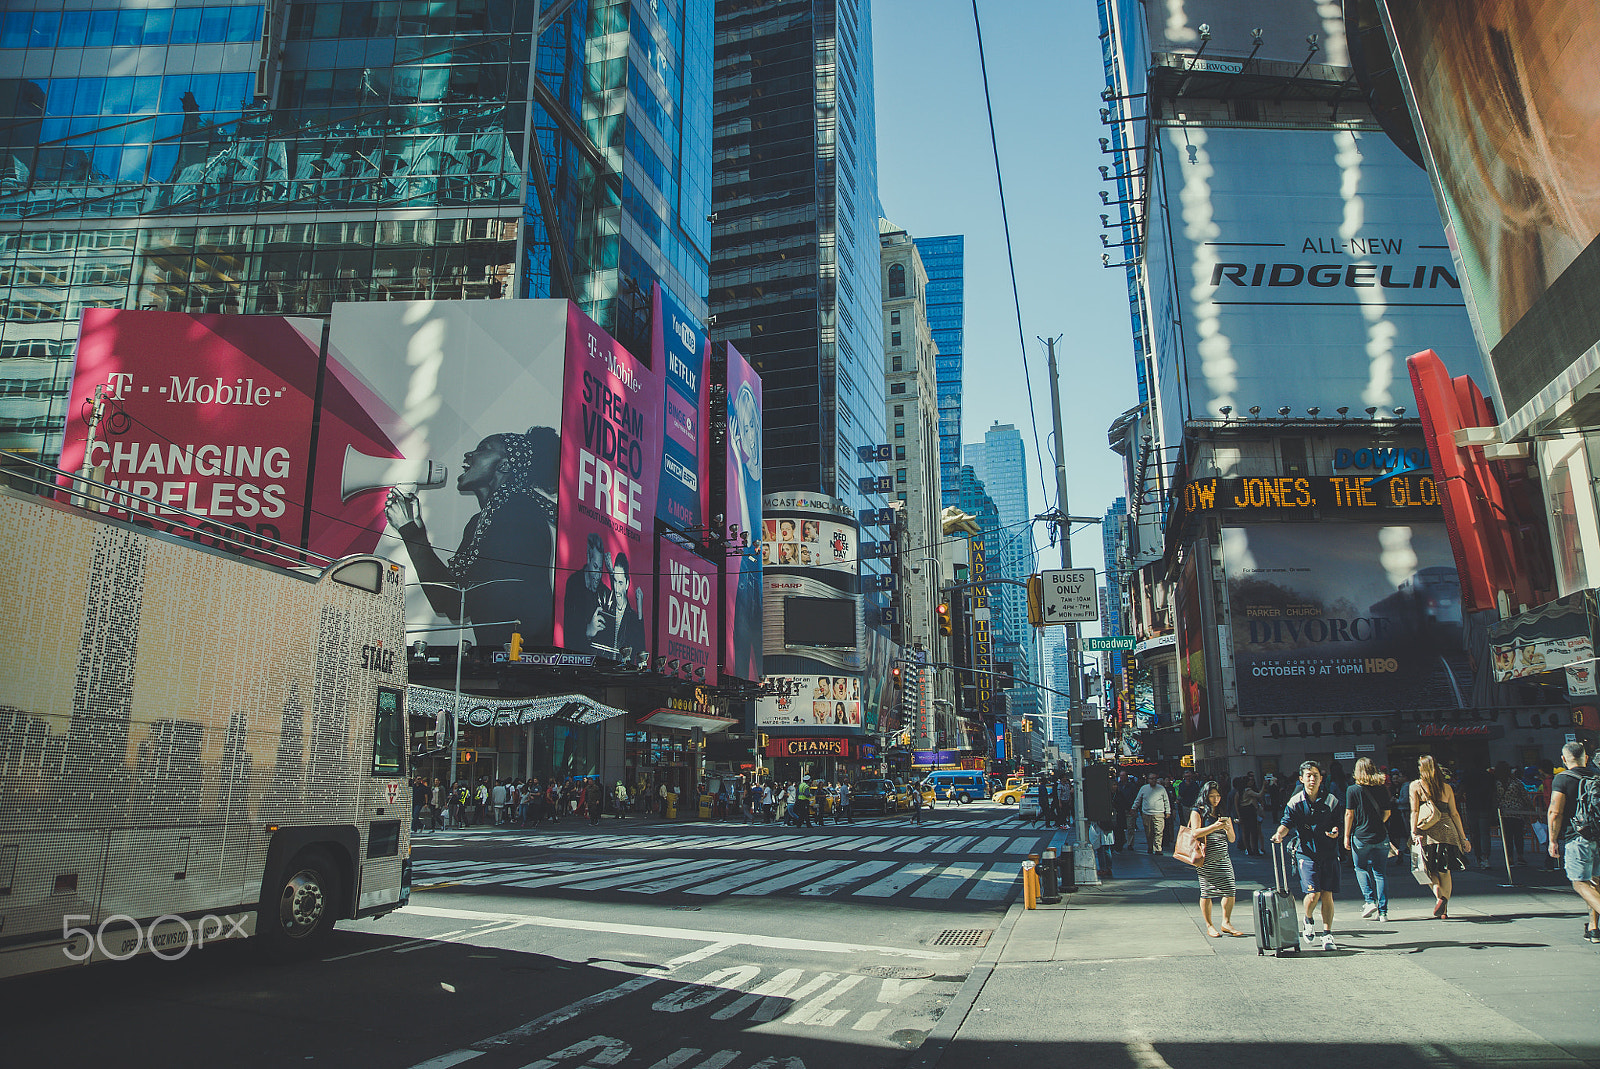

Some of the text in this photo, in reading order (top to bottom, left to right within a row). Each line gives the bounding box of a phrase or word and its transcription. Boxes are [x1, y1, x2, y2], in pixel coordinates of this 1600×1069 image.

[1187, 60, 1241, 73] SHERWOOD
[1302, 237, 1402, 254] ALL-NEW
[669, 351, 696, 393] NETFLIX
[583, 371, 643, 441] STREAM
[582, 404, 642, 480] VIDEO
[91, 441, 290, 478] CHANGING
[100, 479, 286, 518] WIRELESS
[578, 448, 642, 532] FREE
[1235, 477, 1316, 508] JONES,
[1330, 477, 1377, 507] THE
[1389, 477, 1442, 506] GLO
[674, 501, 694, 526] MORE
[833, 531, 847, 541] RED
[879, 447, 892, 621] CHAMPS
[833, 549, 846, 558] DAY
[669, 558, 710, 606] WE DO
[973, 541, 987, 608] MADAME
[1053, 574, 1085, 583] BUSES
[1057, 585, 1081, 594] ONLY
[668, 595, 710, 647] DATA
[1247, 607, 1322, 617] PARKER CHURCH
[669, 640, 709, 666] DIFFERENTLY
[1091, 638, 1133, 650] Broadway
[562, 656, 592, 665] PRIME
[977, 620, 990, 713] TUSSAUDS
[1252, 664, 1364, 677] OCTOBER 9 AT 10PM
[1364, 658, 1399, 673] HBO
[788, 741, 842, 755] CHAMPS
[651, 964, 931, 1032] ONLY
